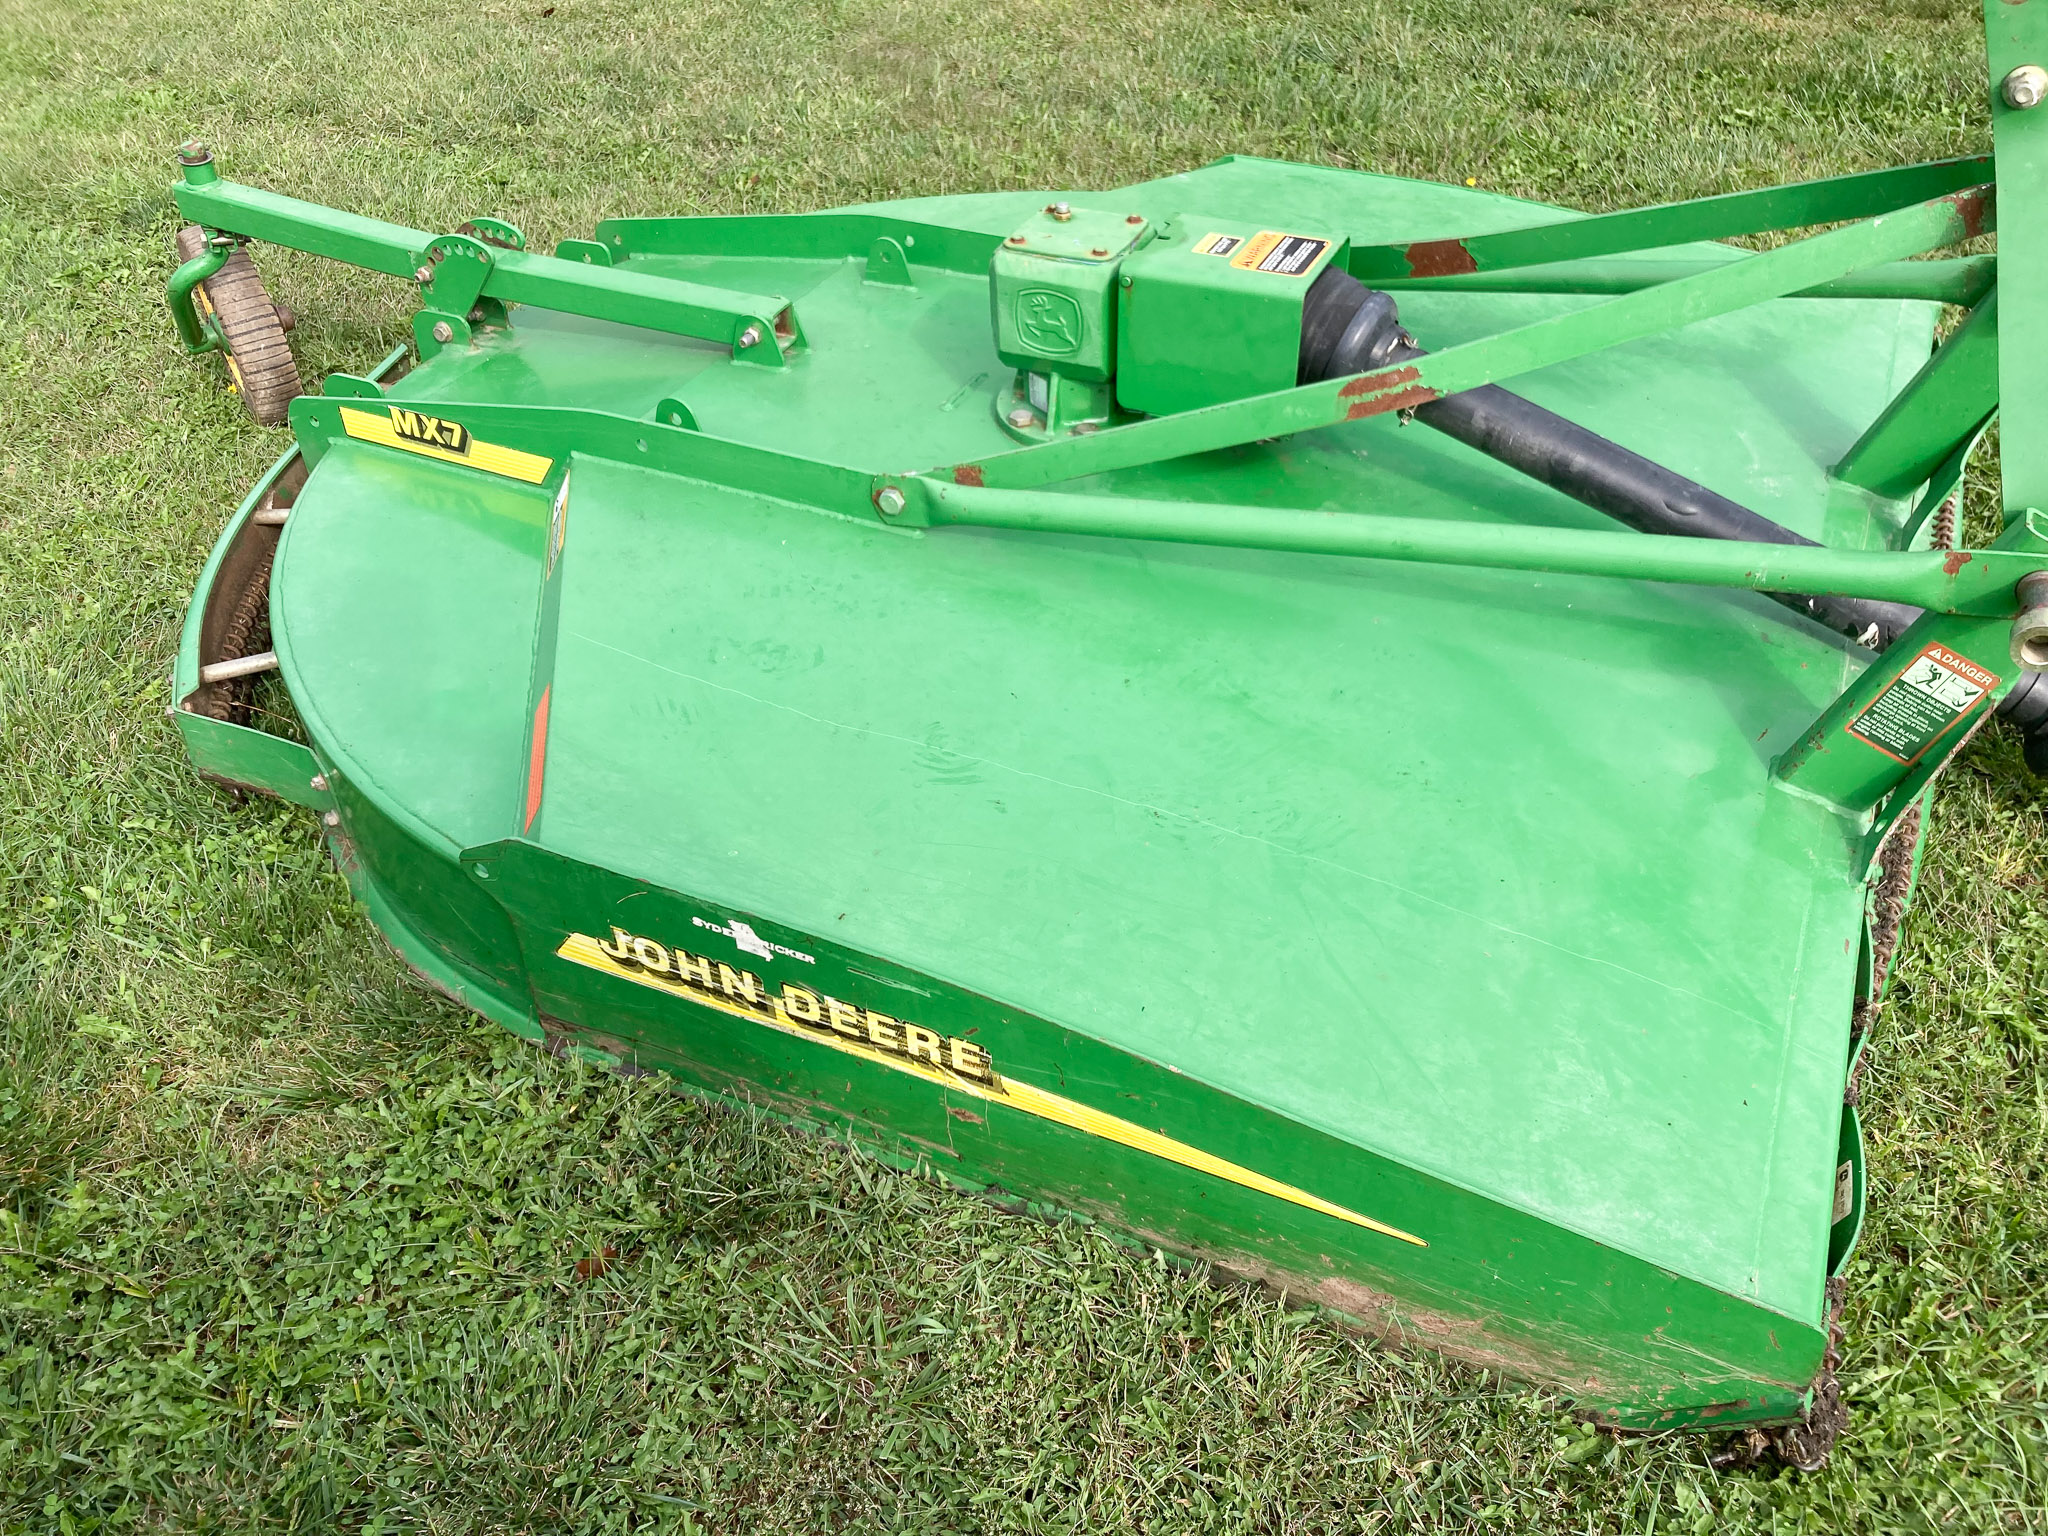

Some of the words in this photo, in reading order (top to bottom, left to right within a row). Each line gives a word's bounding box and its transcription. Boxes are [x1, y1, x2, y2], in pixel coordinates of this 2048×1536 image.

[389, 406, 467, 452] MX7
[1941, 654, 1993, 686] DANGER
[597, 926, 762, 1005] JOHN
[781, 983, 988, 1079] DEERE
